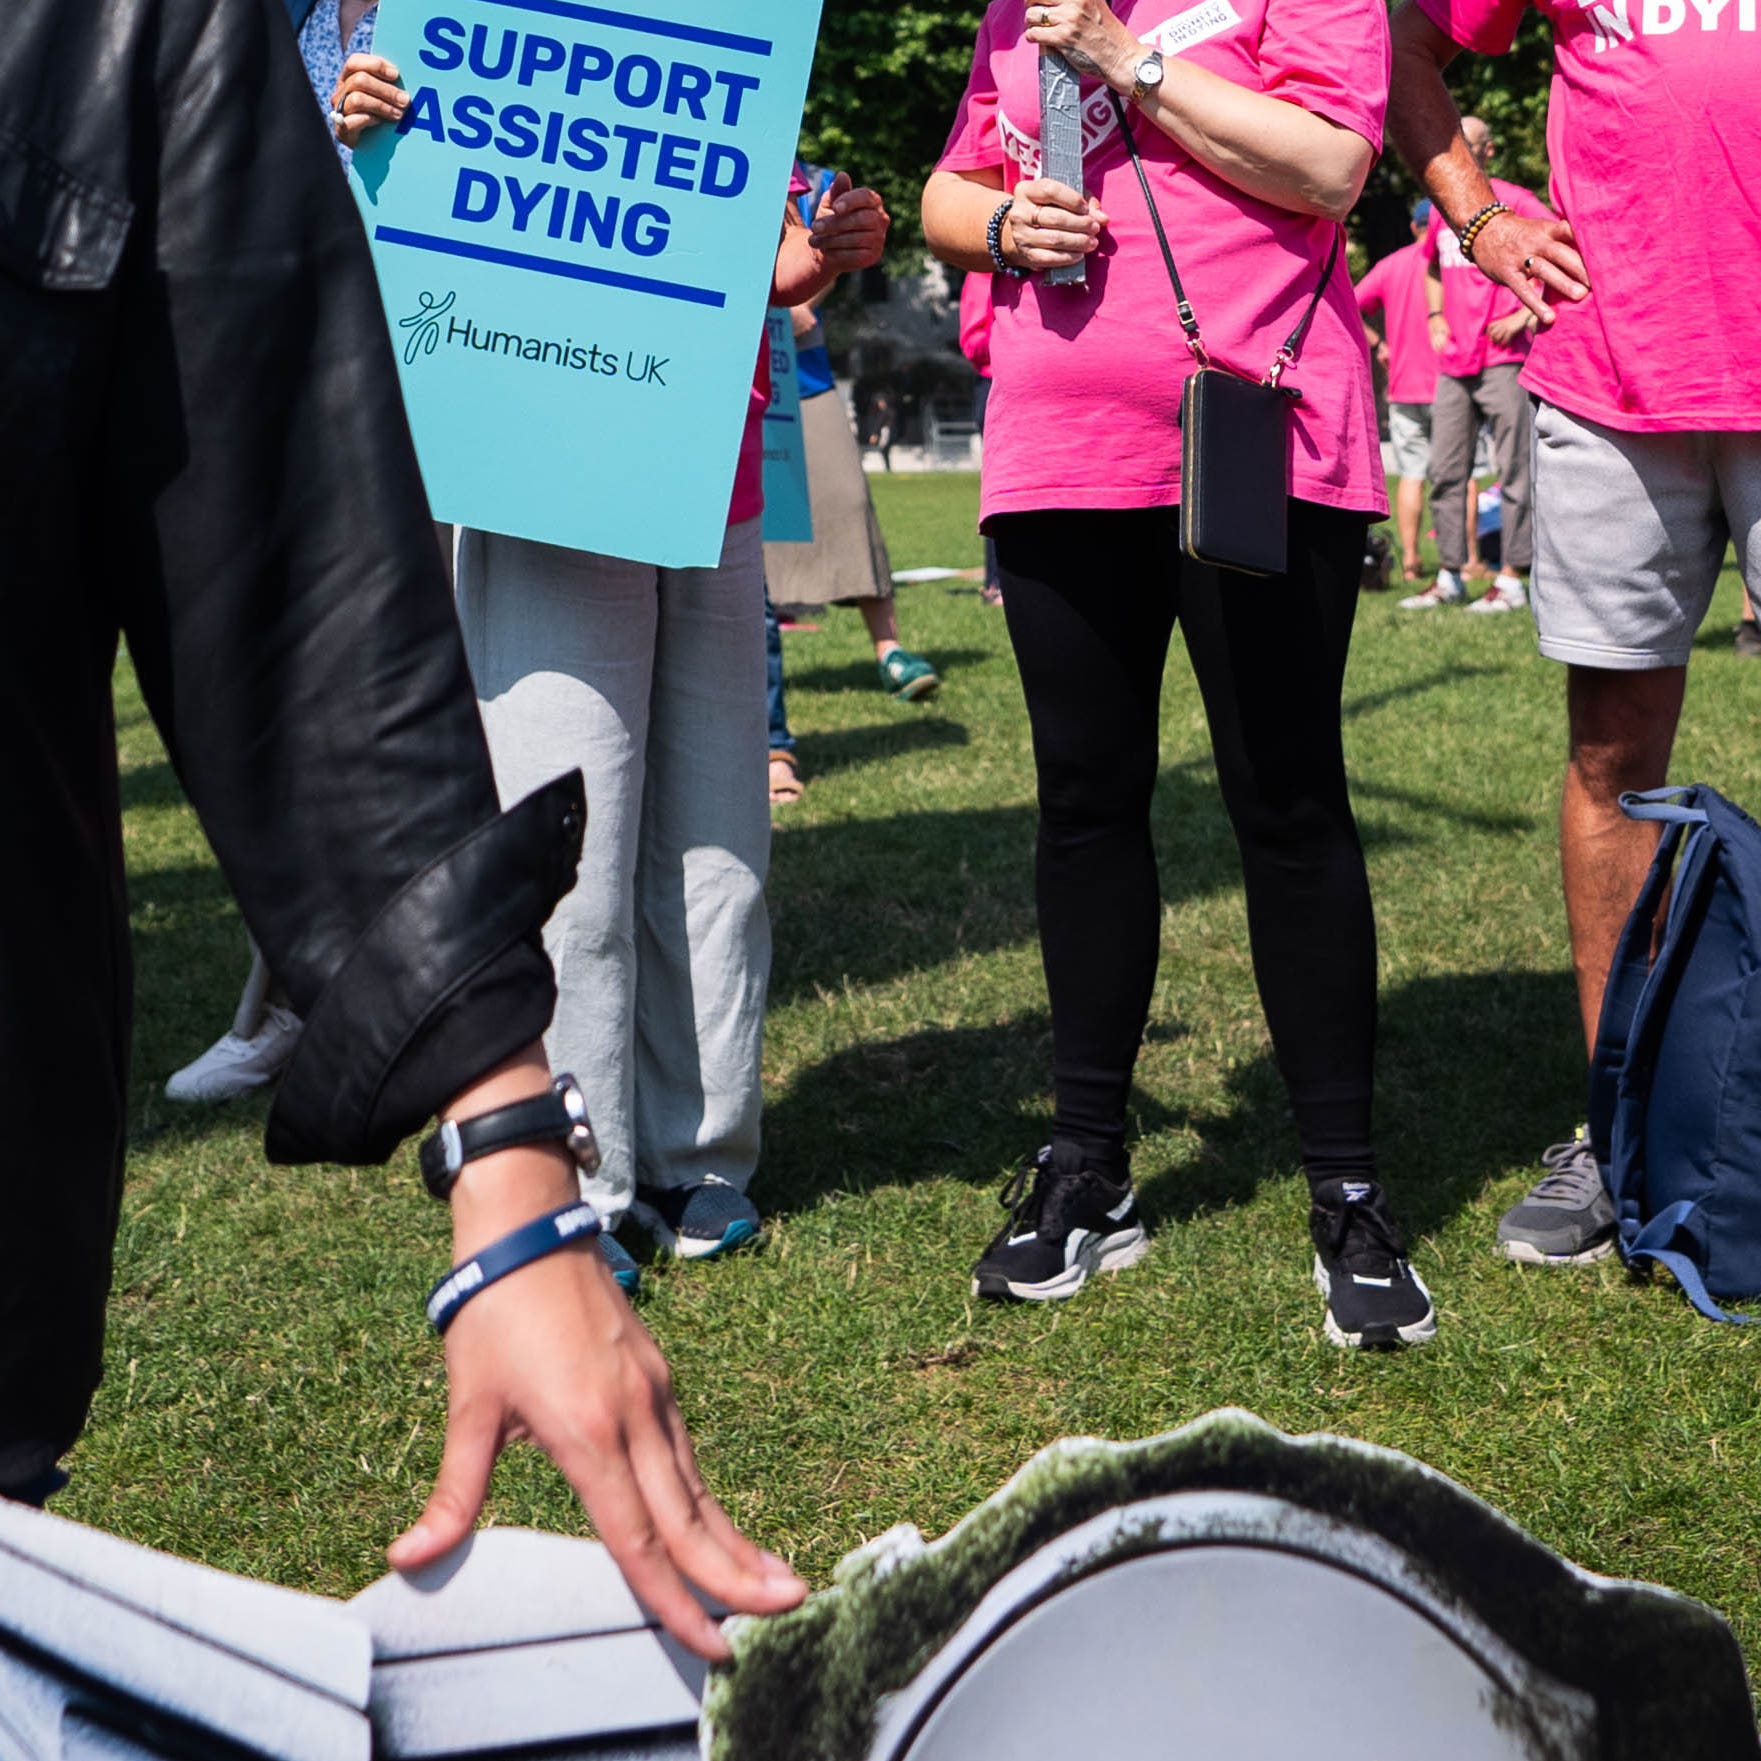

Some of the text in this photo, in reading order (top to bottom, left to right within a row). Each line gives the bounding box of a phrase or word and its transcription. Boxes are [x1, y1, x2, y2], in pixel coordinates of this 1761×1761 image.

[418, 16, 761, 127] SUPPORT
[395, 85, 750, 198] ASSISTED
[451, 167, 672, 257] DYING
[446, 316, 670, 386] Humanists UK
